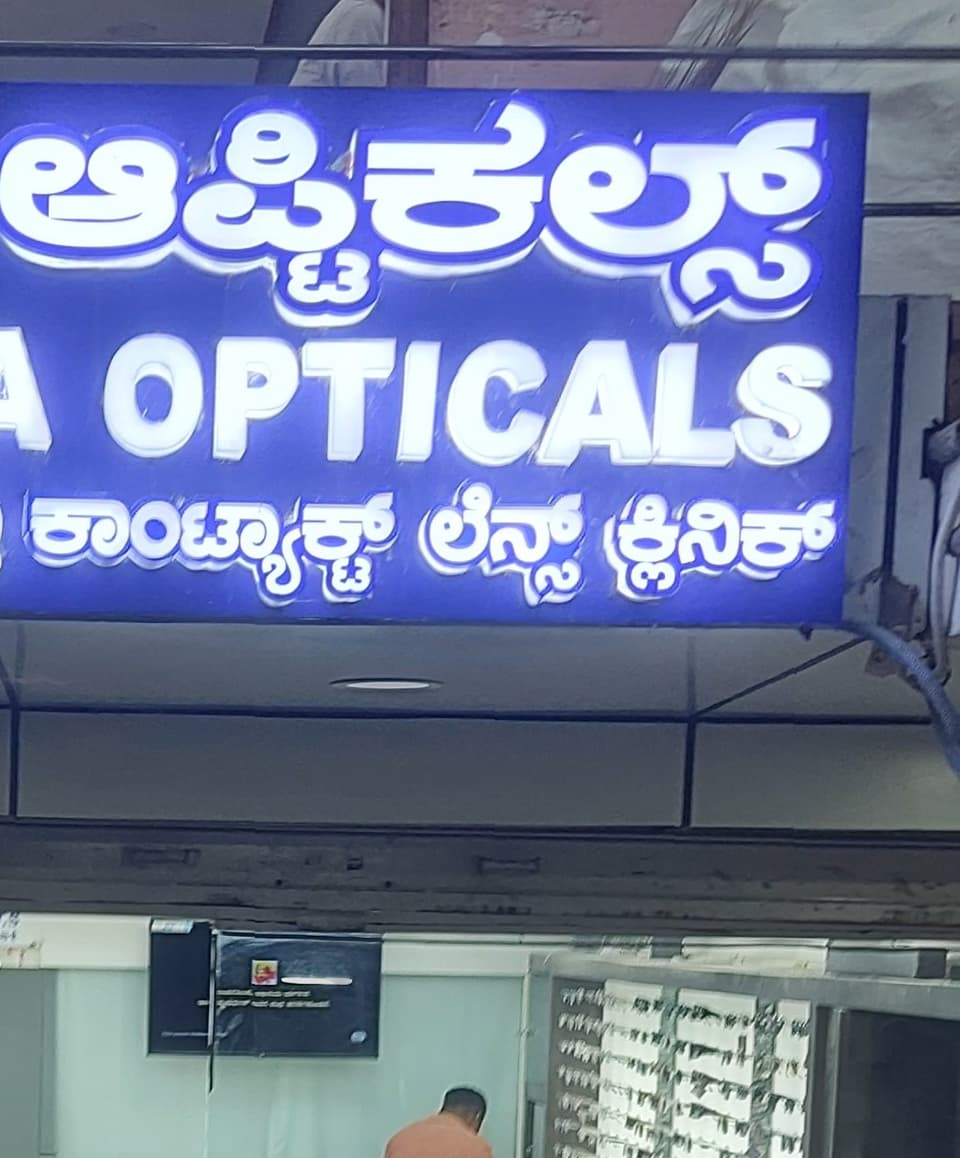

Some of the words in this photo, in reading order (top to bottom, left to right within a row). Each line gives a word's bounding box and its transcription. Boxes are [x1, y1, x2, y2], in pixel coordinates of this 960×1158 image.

[103, 333, 833, 468] OPTICALS
[28, 491, 394, 605] ಕಾಂಟ್ಯಾಕ್ಟ್
[420, 480, 583, 604] ಲೆನ್ಸ್
[608, 488, 838, 599] ಕ್ಲಿನಿಕ್
